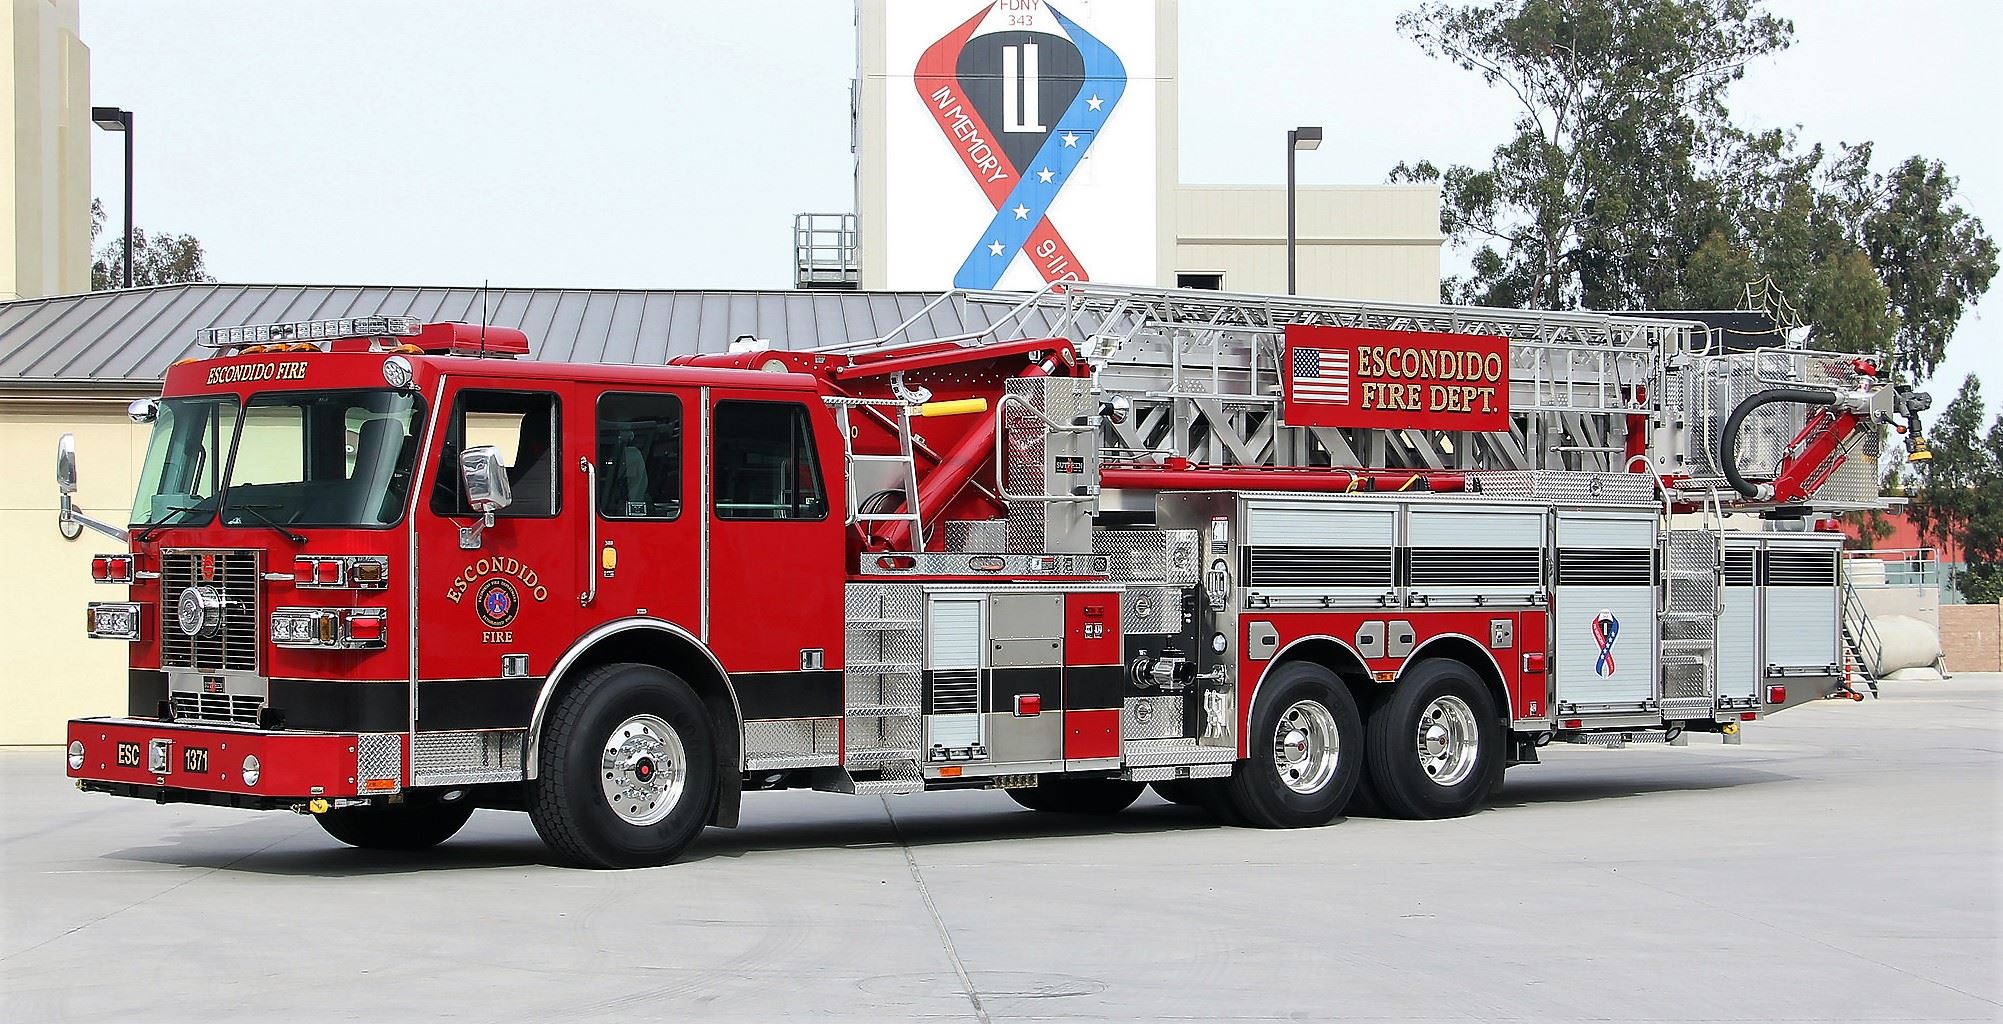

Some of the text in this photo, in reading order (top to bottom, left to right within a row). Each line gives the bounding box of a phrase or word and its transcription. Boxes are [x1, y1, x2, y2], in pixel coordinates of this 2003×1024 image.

[1000, 0, 1040, 11] FDNY
[1008, 14, 1033, 26] 343
[931, 85, 1009, 183] IN MEMORY
[206, 361, 308, 385] ESCONDIDO FIRE
[1357, 346, 1502, 383] ESCONDIDO
[1361, 382, 1498, 413] FIRE DEPT.
[446, 556, 548, 604] ESCONDIDO
[482, 631, 513, 643] FIRE
[118, 743, 140, 766] ESC
[185, 749, 208, 771] 1371
